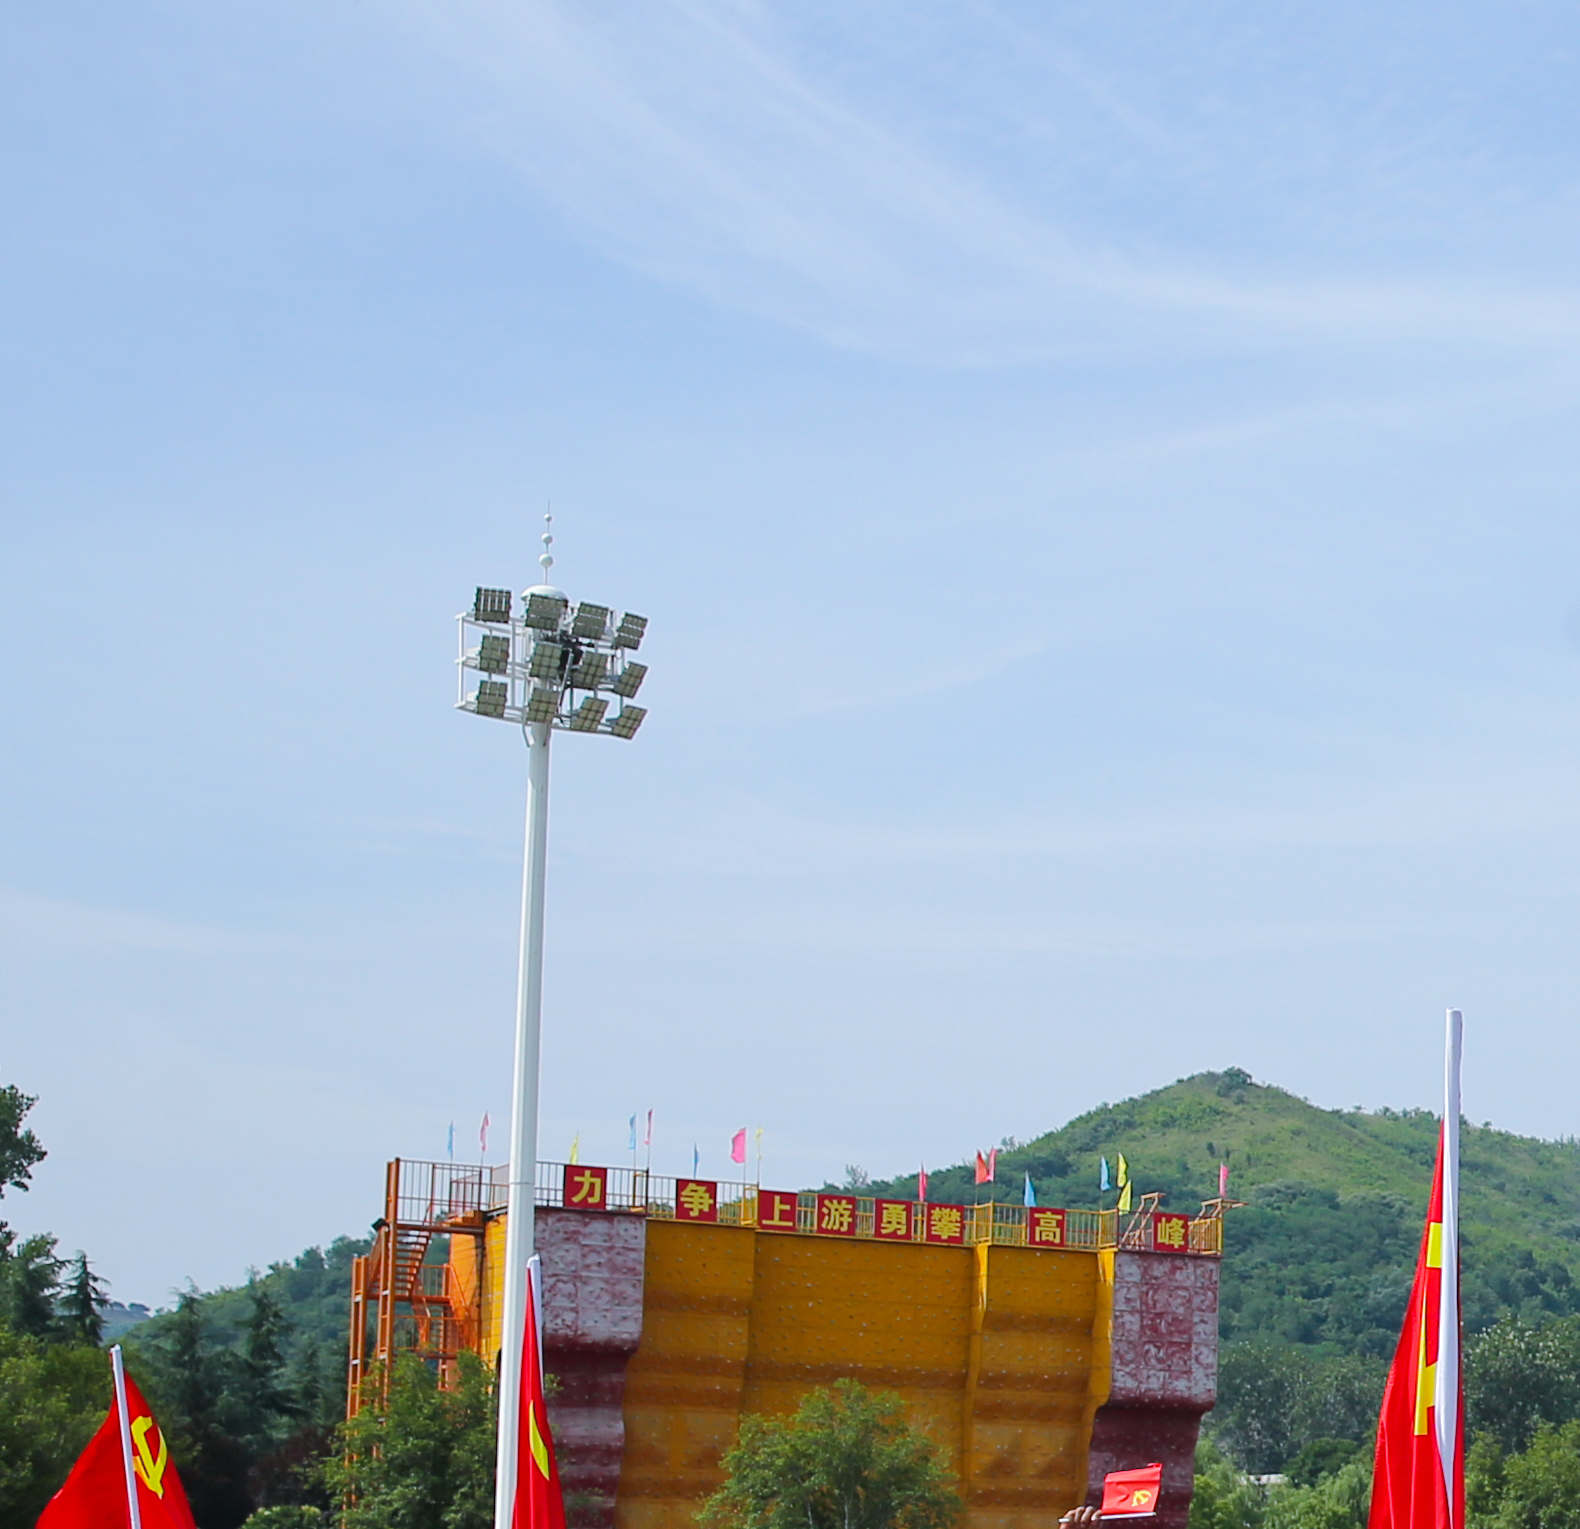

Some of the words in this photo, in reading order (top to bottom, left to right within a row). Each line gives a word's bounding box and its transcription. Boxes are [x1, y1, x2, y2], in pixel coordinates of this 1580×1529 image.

[572, 1169, 1185, 1249] 力争上游勇攀高峰
